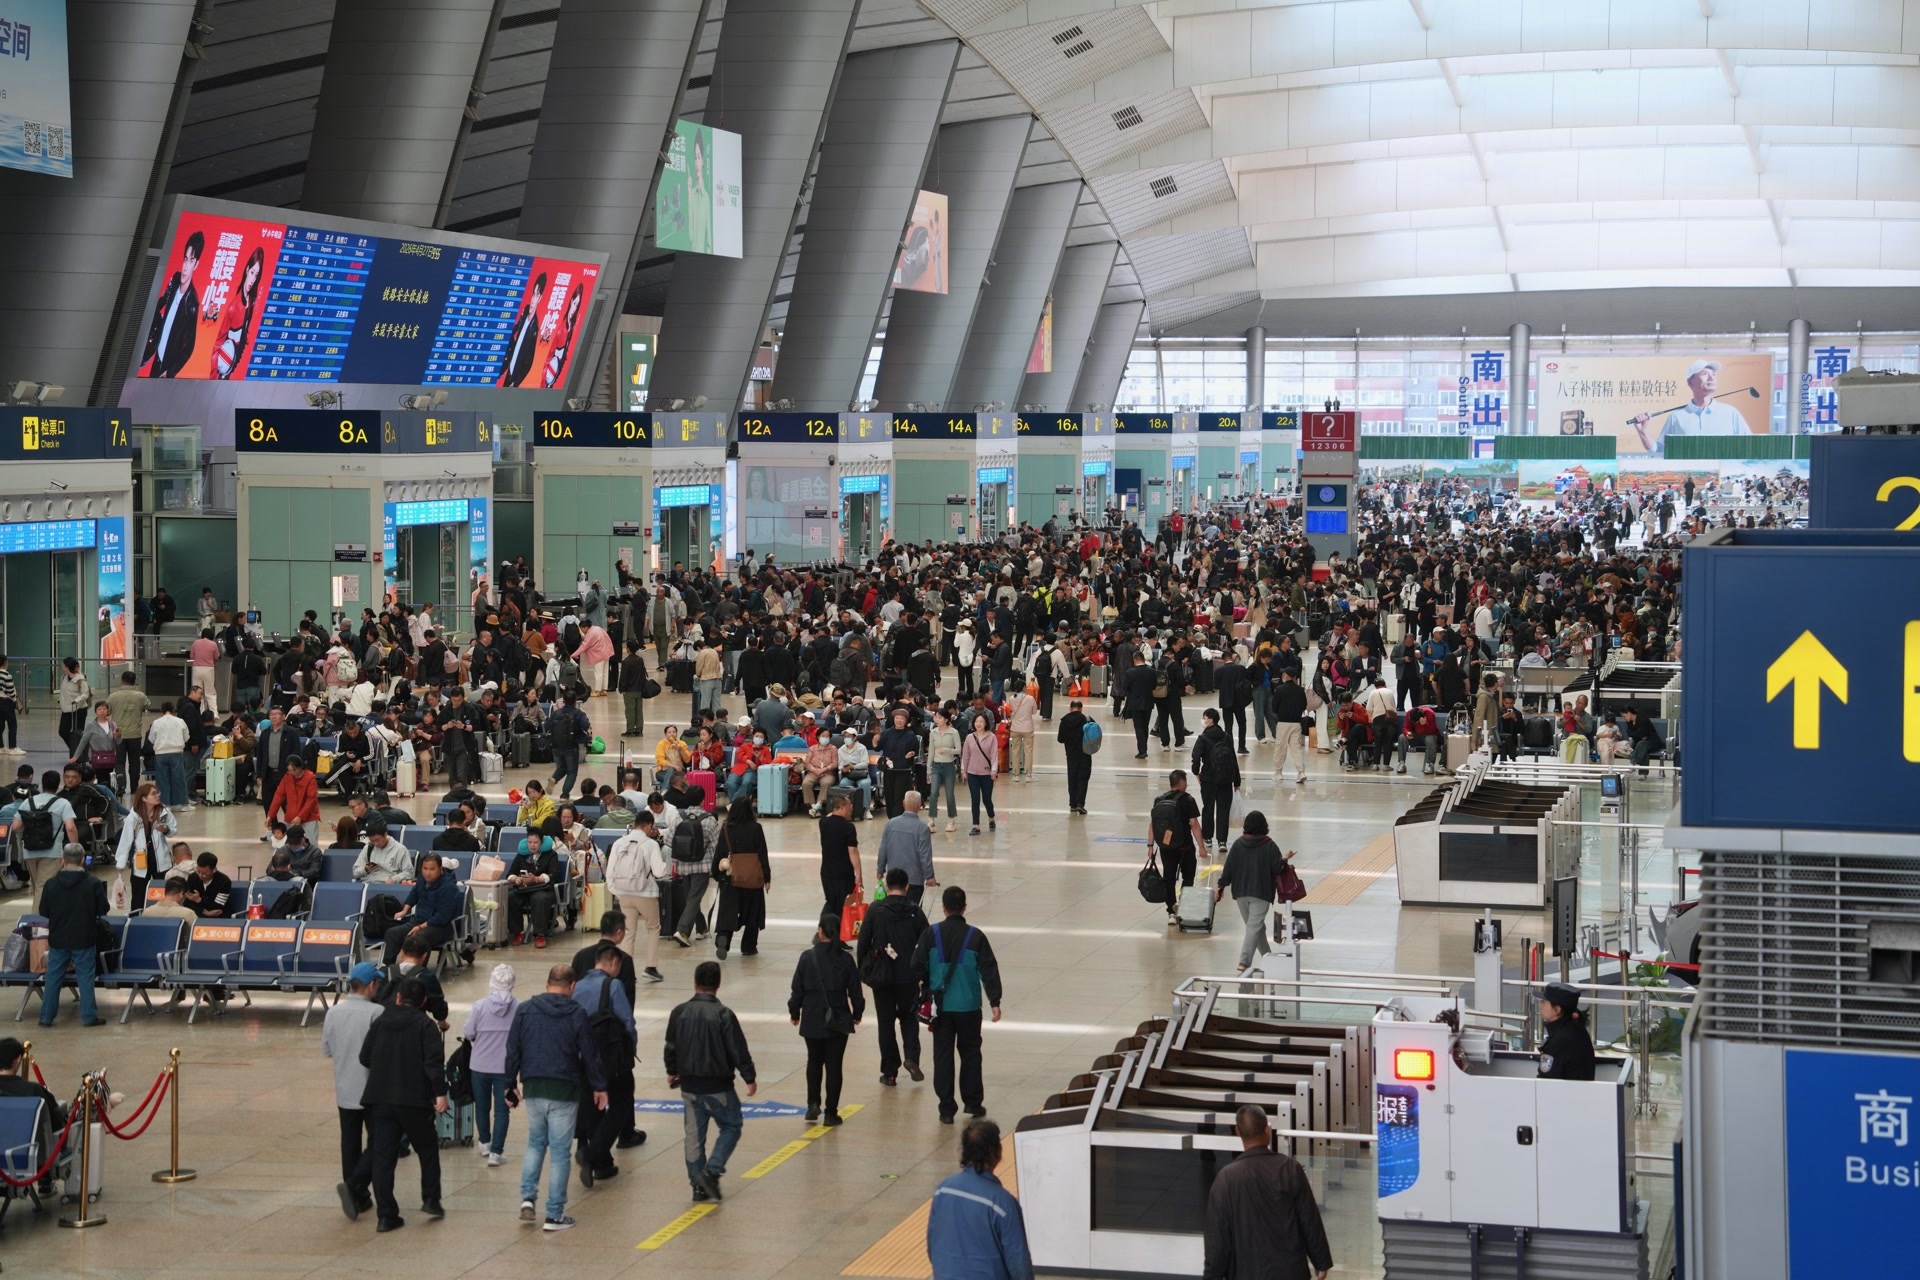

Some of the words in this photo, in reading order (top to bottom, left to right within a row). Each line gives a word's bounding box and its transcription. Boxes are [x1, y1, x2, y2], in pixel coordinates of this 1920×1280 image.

[287, 229, 298, 238] 车次
[210, 249, 239, 281] 就要
[202, 281, 229, 312] 小牛
[382, 287, 429, 304] 铁路安全你我他
[548, 286, 568, 310] 就要
[372, 323, 420, 339] 共筑平安靠大家
[1459, 376, 1470, 417] South
[1557, 380, 1614, 398] 八子补肾精
[1619, 380, 1677, 398] 粒粒敬年轻
[1801, 374, 1812, 415] South
[41, 419, 66, 436] 检票口
[437, 421, 452, 434] 检票口
[540, 420, 573, 439] 10A
[744, 420, 772, 436] 12A
[806, 420, 834, 436] 12A
[894, 419, 918, 433] 14A
[948, 419, 972, 433] 14A
[1056, 418, 1078, 431] 16A
[1149, 418, 1168, 428] 18A
[1218, 418, 1237, 428] 20A
[1276, 416, 1294, 426] 22A
[111, 420, 128, 447] 7A
[249, 419, 278, 442] 8A
[340, 420, 368, 444] 8A
[384, 421, 396, 444] 8A
[478, 421, 490, 442] 9A
[614, 420, 646, 440] 10A
[41, 440, 54, 448] Check
[55, 440, 60, 448] in
[208, 930, 238, 938] 爱心专座
[264, 930, 293, 939] 爱心专座
[1855, 1088, 1912, 1146] 商
[1846, 1156, 1920, 1188] Busi
